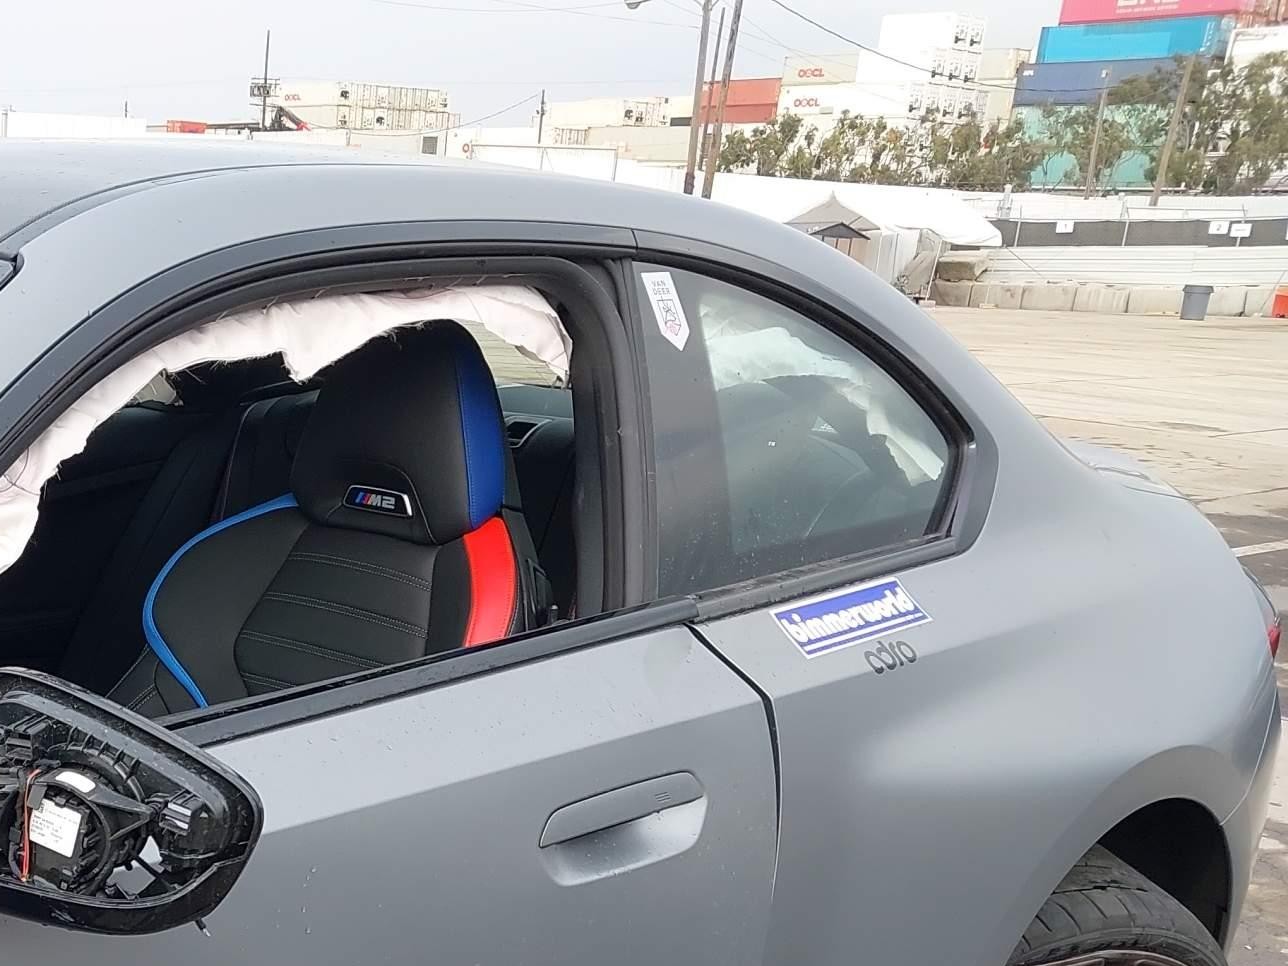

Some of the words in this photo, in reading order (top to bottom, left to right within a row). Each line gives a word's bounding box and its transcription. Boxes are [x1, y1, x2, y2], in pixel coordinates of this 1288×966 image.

[797, 68, 825, 78] OOCL
[793, 98, 820, 107] OOCL
[780, 586, 915, 643] bimmerworld
